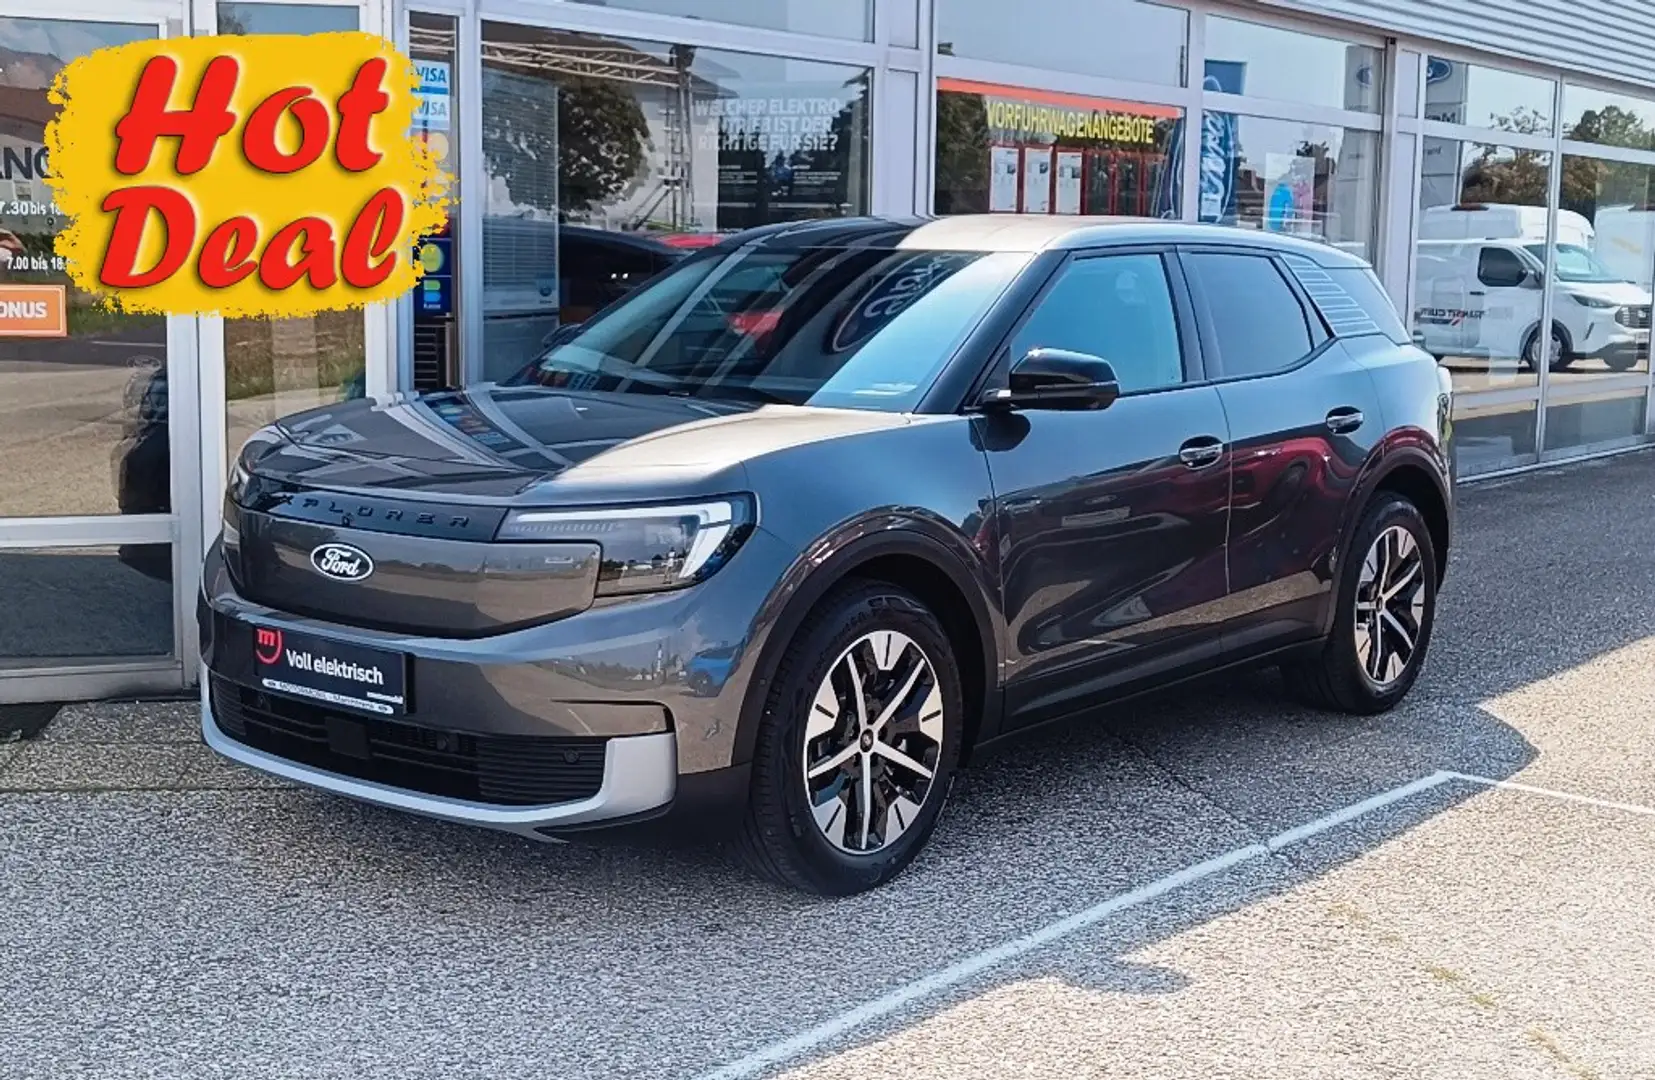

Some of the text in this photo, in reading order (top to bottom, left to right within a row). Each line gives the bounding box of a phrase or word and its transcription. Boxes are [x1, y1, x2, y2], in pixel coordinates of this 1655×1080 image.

[694, 98, 768, 116] WELCHER
[775, 116, 798, 133] IST
[800, 115, 834, 134] DER
[984, 99, 1155, 144] VORFÜHRWAGENANGEBOTE
[802, 134, 839, 150] SIE?
[30, 201, 47, 215] bis
[7, 256, 29, 270] 7.00
[31, 256, 48, 270] bis
[285, 648, 385, 686] Voll elektrisch
